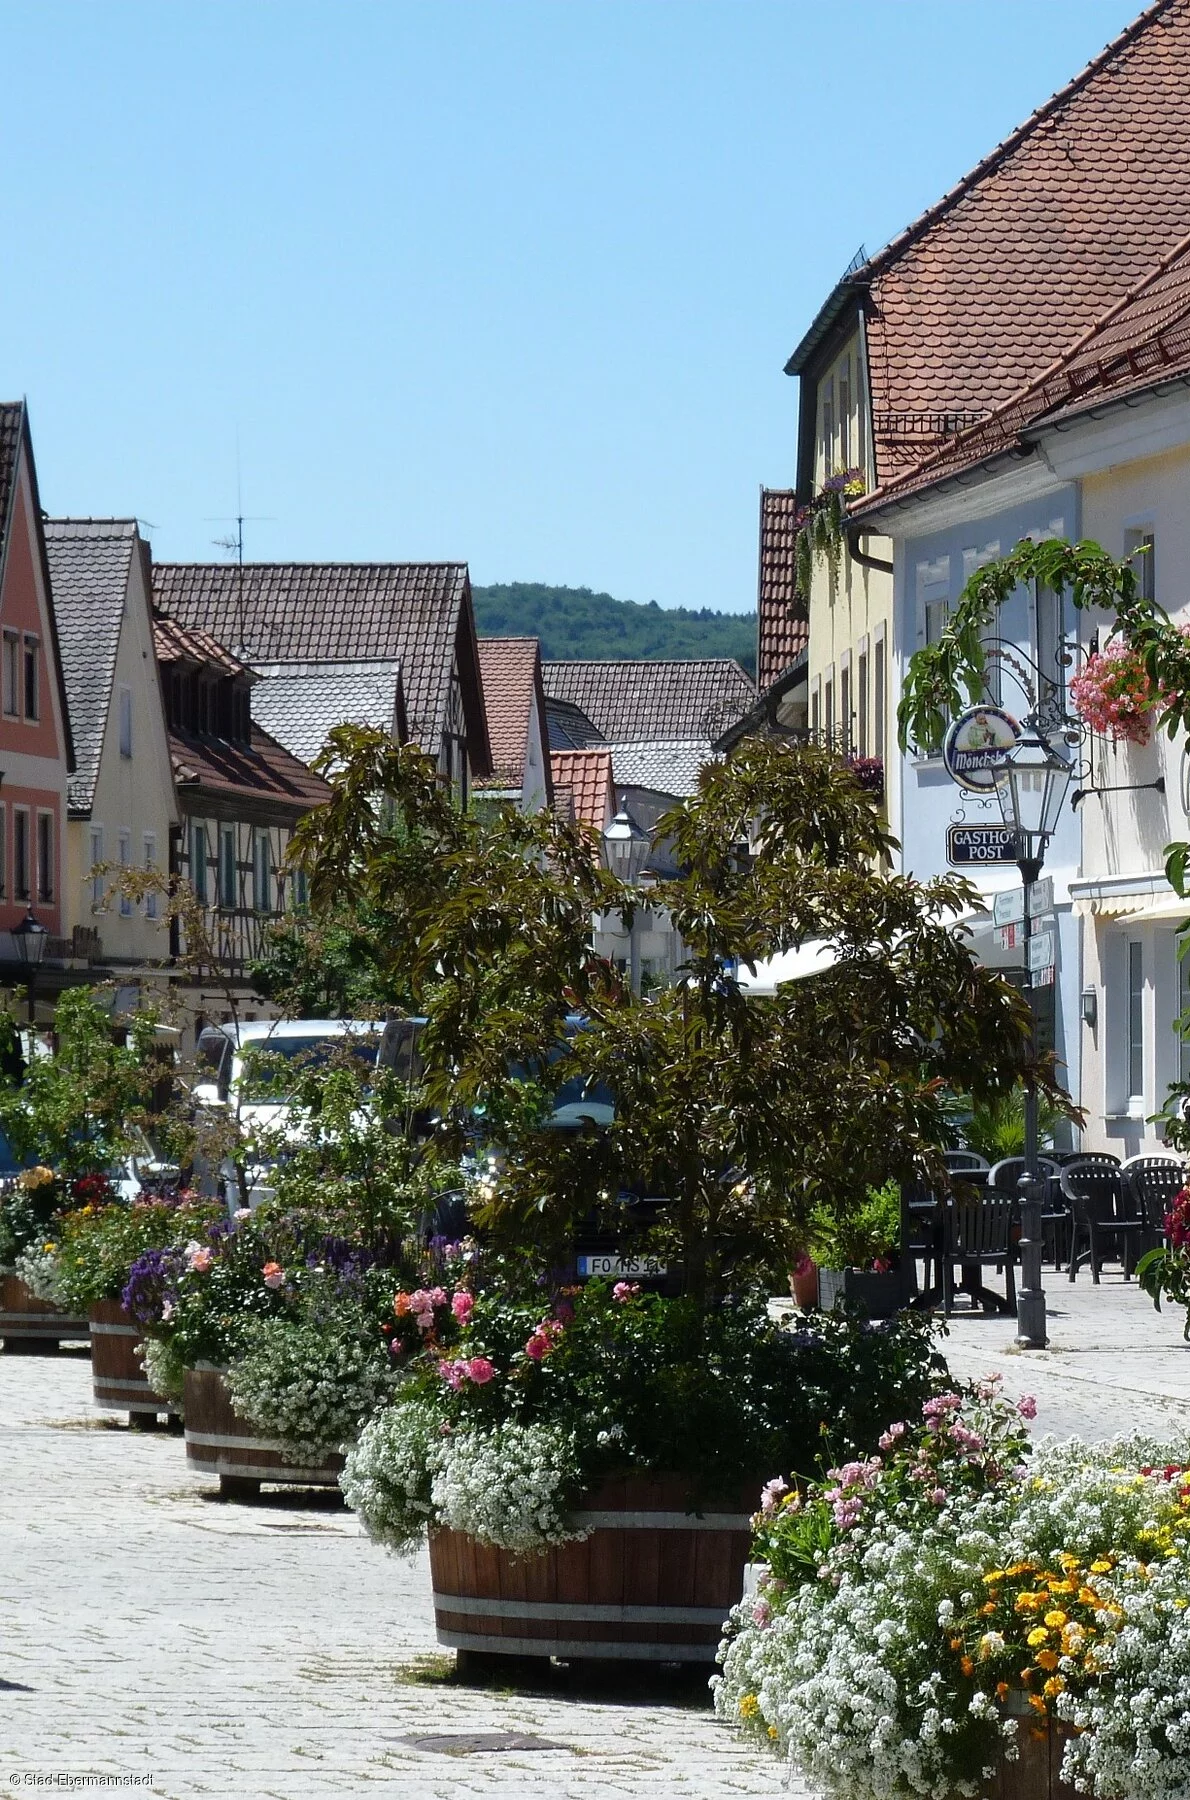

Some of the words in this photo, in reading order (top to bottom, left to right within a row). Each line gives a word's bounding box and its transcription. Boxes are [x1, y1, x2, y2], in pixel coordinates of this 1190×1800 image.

[955, 750, 1004, 770] Mönchsh
[953, 830, 1014, 846] GASTHO
[968, 845, 1004, 860] POST
[592, 1258, 611, 1273] FO
